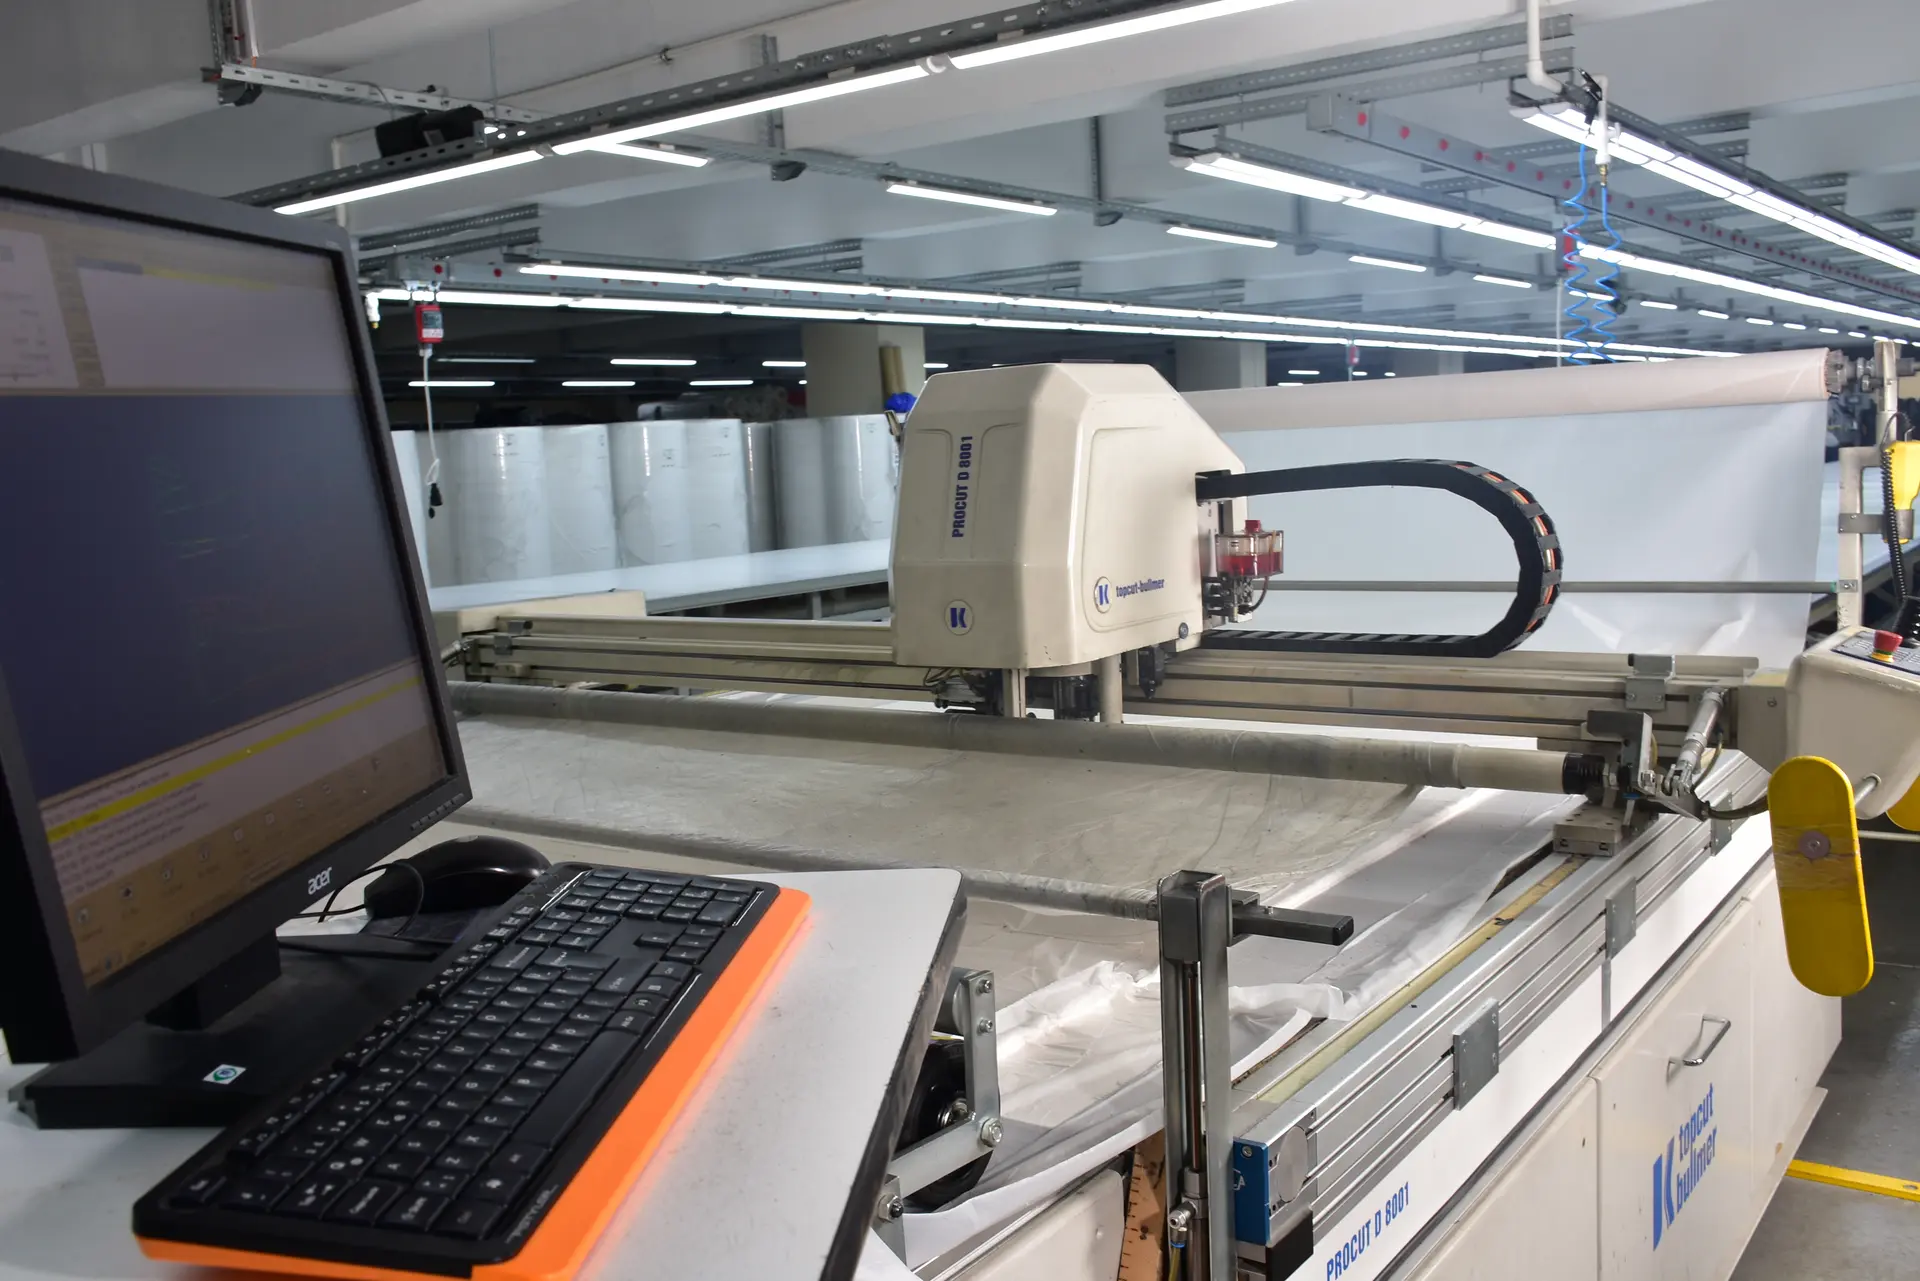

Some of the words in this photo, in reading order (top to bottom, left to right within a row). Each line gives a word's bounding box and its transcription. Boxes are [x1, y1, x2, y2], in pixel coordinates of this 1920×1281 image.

[957, 472, 970, 481] D
[959, 435, 973, 468] 8001
[952, 484, 969, 537] PROCUT
[307, 866, 333, 895] acer
[1678, 1082, 1714, 1163] topcut
[1676, 1125, 1718, 1215] bullmer
[1326, 1219, 1372, 1281] PROCUT
[1374, 1210, 1382, 1238] D
[1385, 1181, 1409, 1226] 8001
